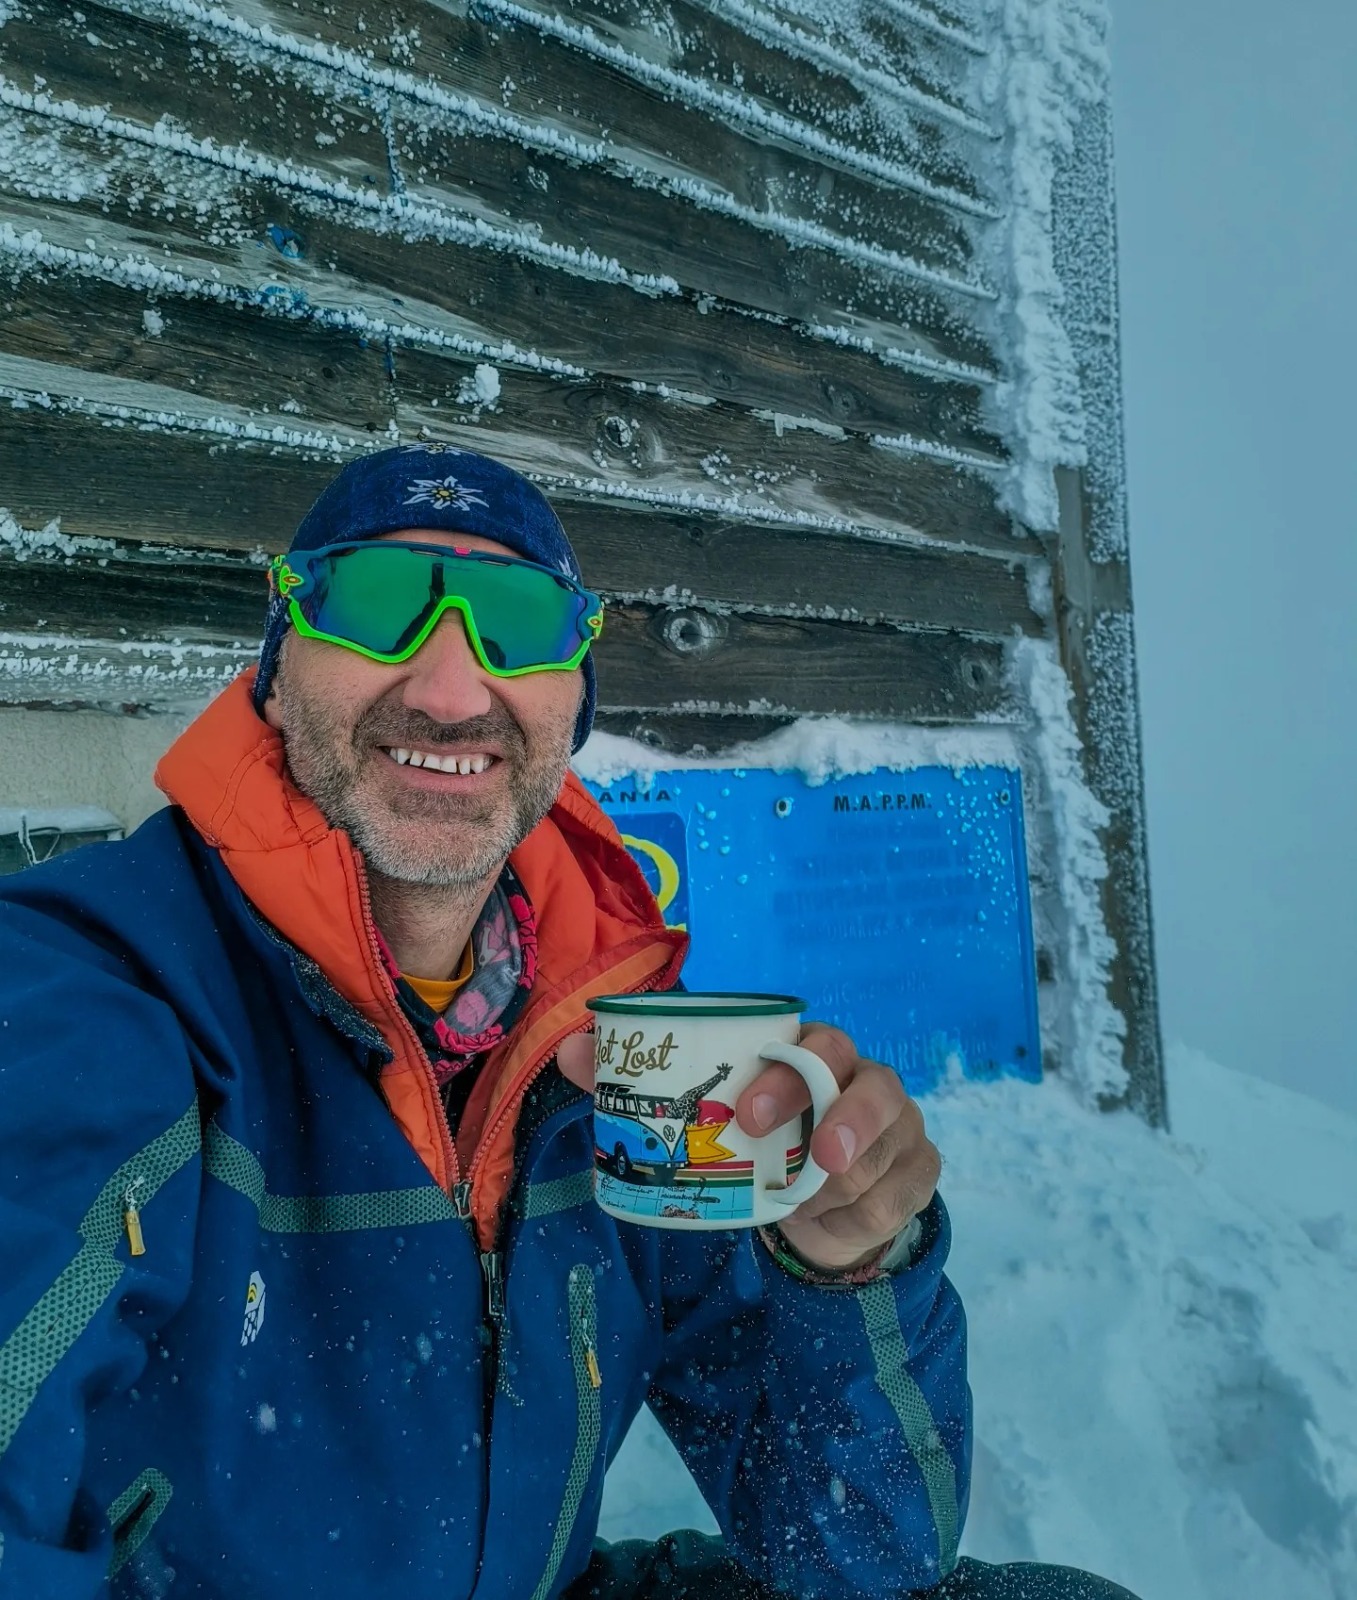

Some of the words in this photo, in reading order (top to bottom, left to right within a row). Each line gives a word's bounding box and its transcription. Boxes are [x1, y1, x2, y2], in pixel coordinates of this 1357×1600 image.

[599, 789, 671, 803] ANIA
[833, 793, 933, 812] M.A.P.P.M.
[615, 1031, 679, 1077] Lost
